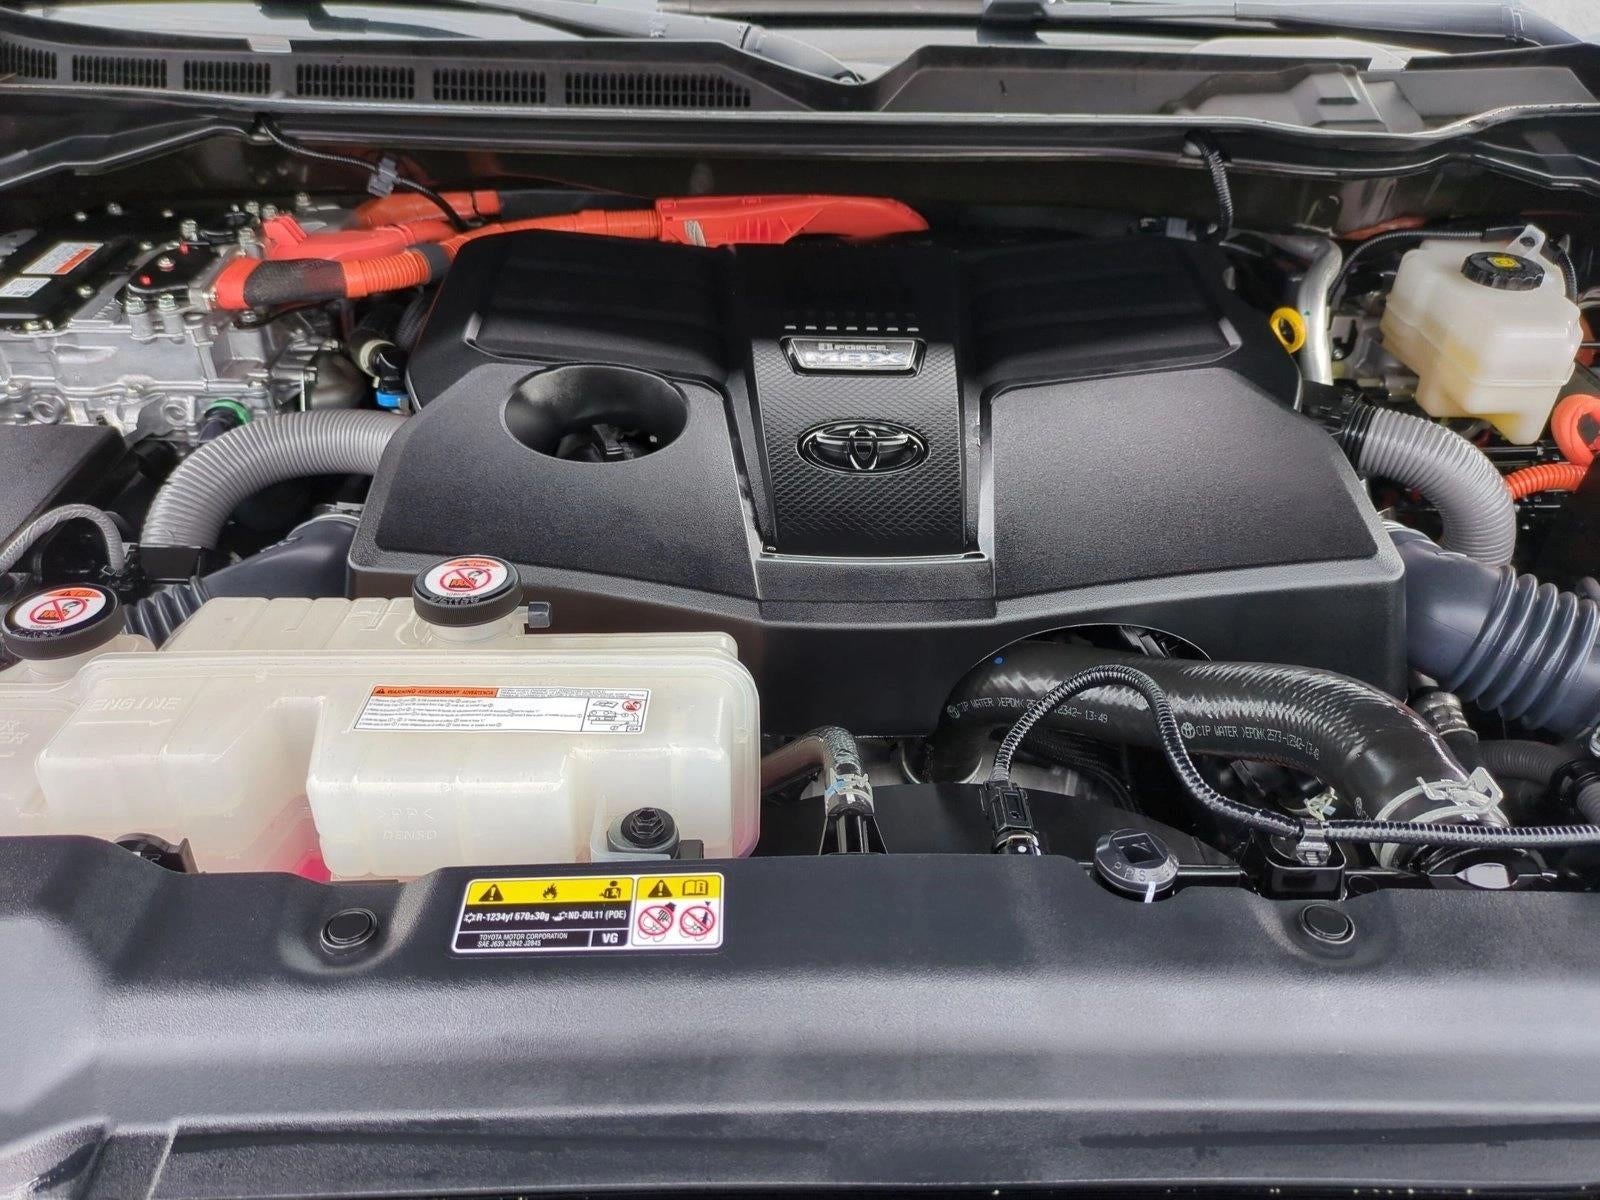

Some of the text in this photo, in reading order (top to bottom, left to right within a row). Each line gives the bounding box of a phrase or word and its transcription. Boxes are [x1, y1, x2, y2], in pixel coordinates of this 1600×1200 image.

[970, 697, 994, 709] WATER
[1195, 725, 1211, 737] CIP
[1214, 725, 1239, 738] WATER
[475, 912, 514, 923] R-1234yf
[604, 909, 627, 920] (POE)
[480, 933, 502, 941] TOYOTA
[525, 932, 569, 940] CORPORATION
[602, 932, 619, 944] VG
[490, 940, 505, 948] J639
